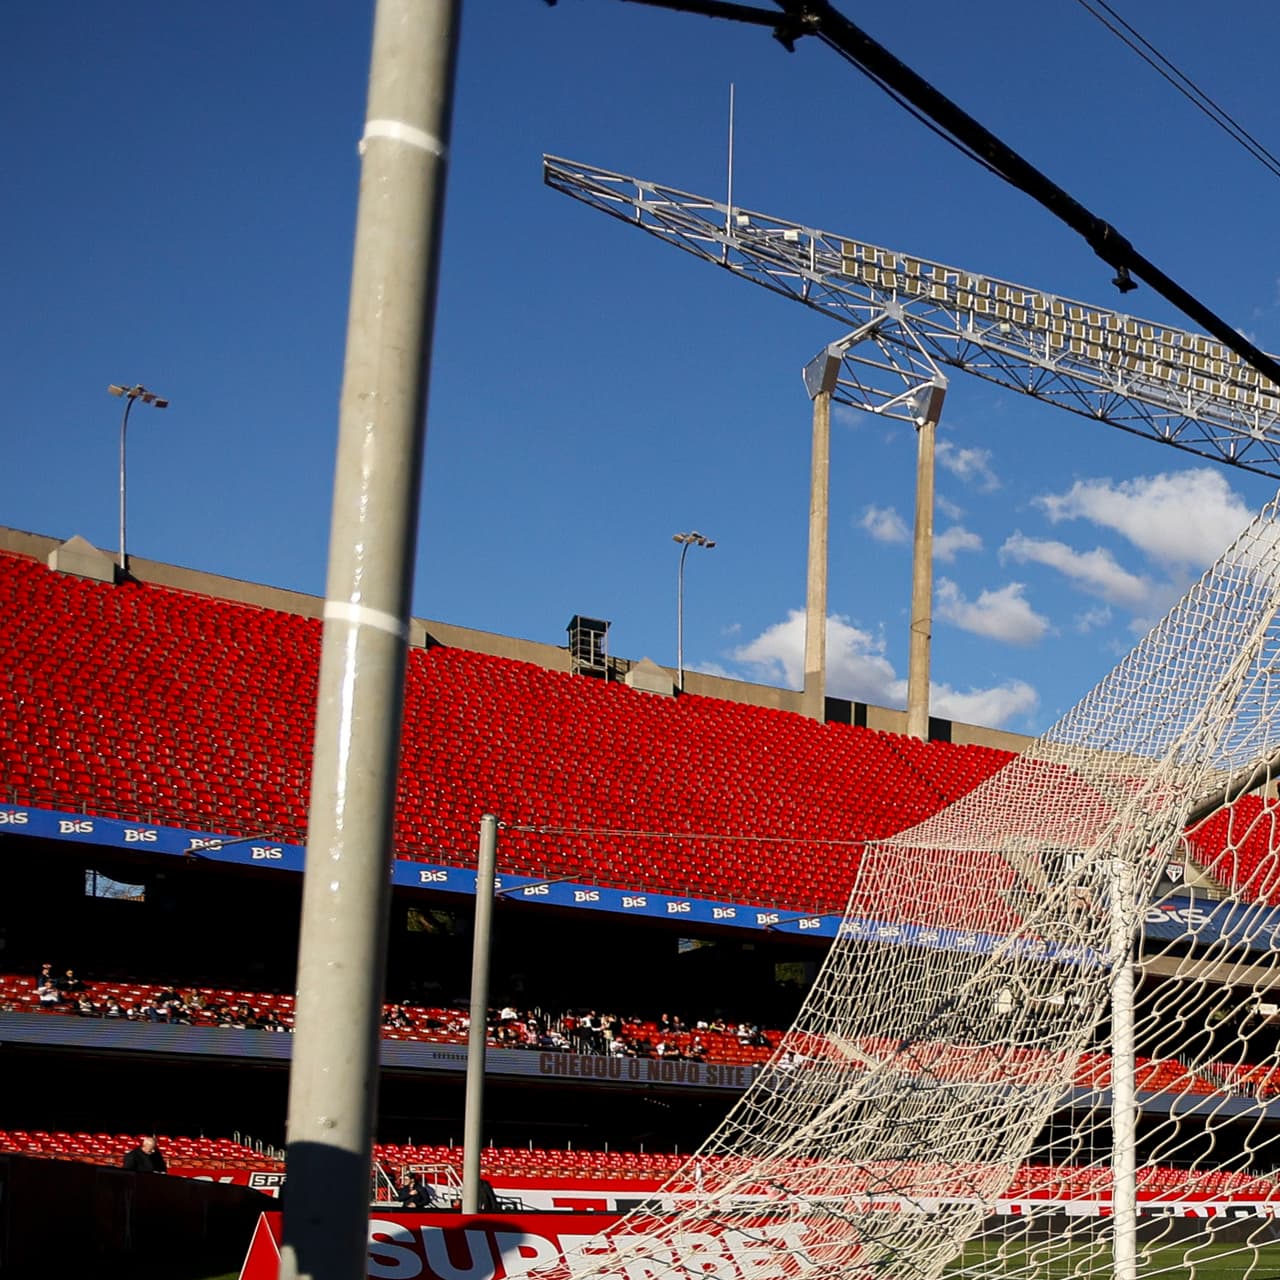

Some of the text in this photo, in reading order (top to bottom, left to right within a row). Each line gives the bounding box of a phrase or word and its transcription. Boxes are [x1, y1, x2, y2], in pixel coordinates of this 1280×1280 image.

[540, 1053, 621, 1079] CHEGOU
[629, 1058, 640, 1080] O
[648, 1061, 699, 1083] NOVO
[707, 1065, 745, 1087] SITE
[255, 1176, 287, 1187] SPF
